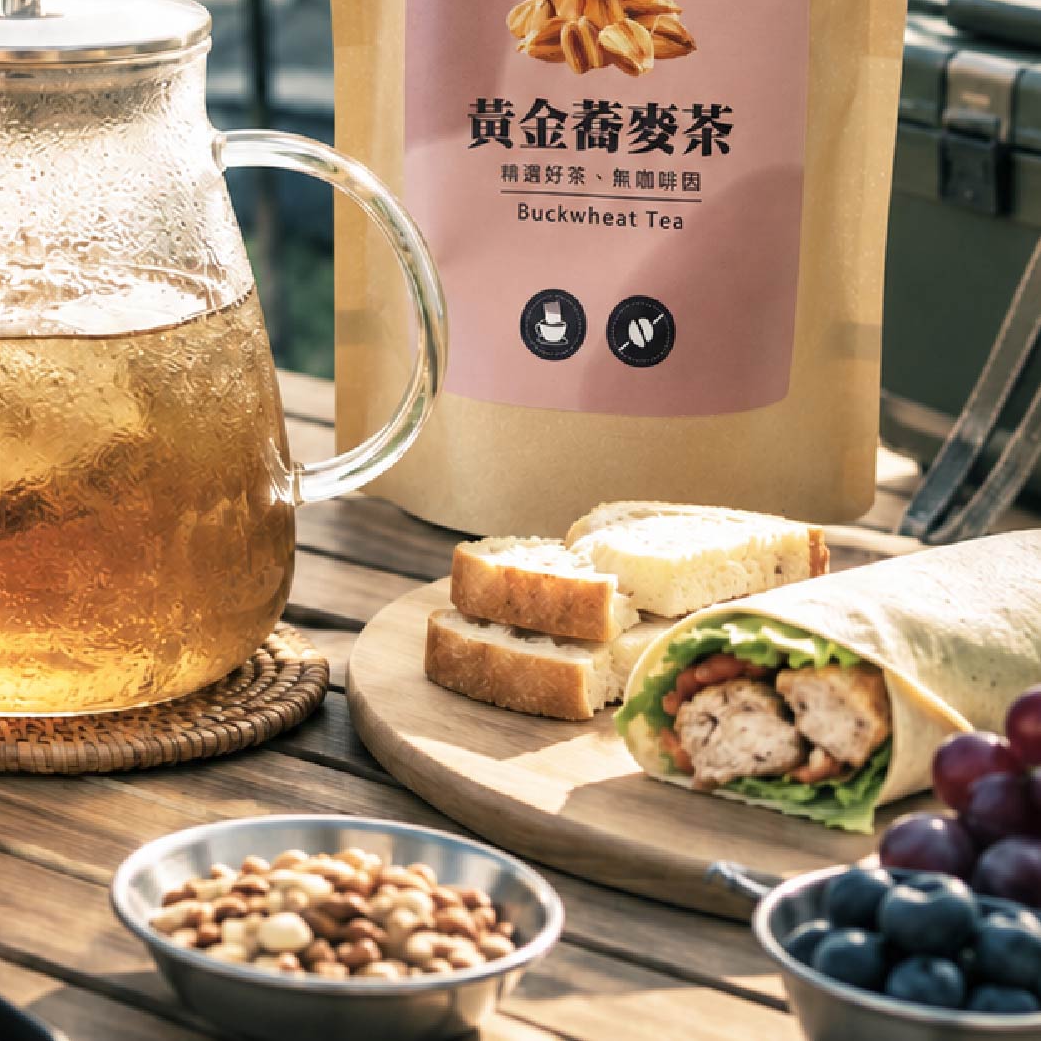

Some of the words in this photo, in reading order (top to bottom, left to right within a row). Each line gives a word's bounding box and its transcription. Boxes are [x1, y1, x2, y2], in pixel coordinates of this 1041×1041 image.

[468, 98, 734, 157] 黃金蕎麥茶
[517, 202, 638, 228] Buckwheat
[646, 210, 684, 230] Tea
